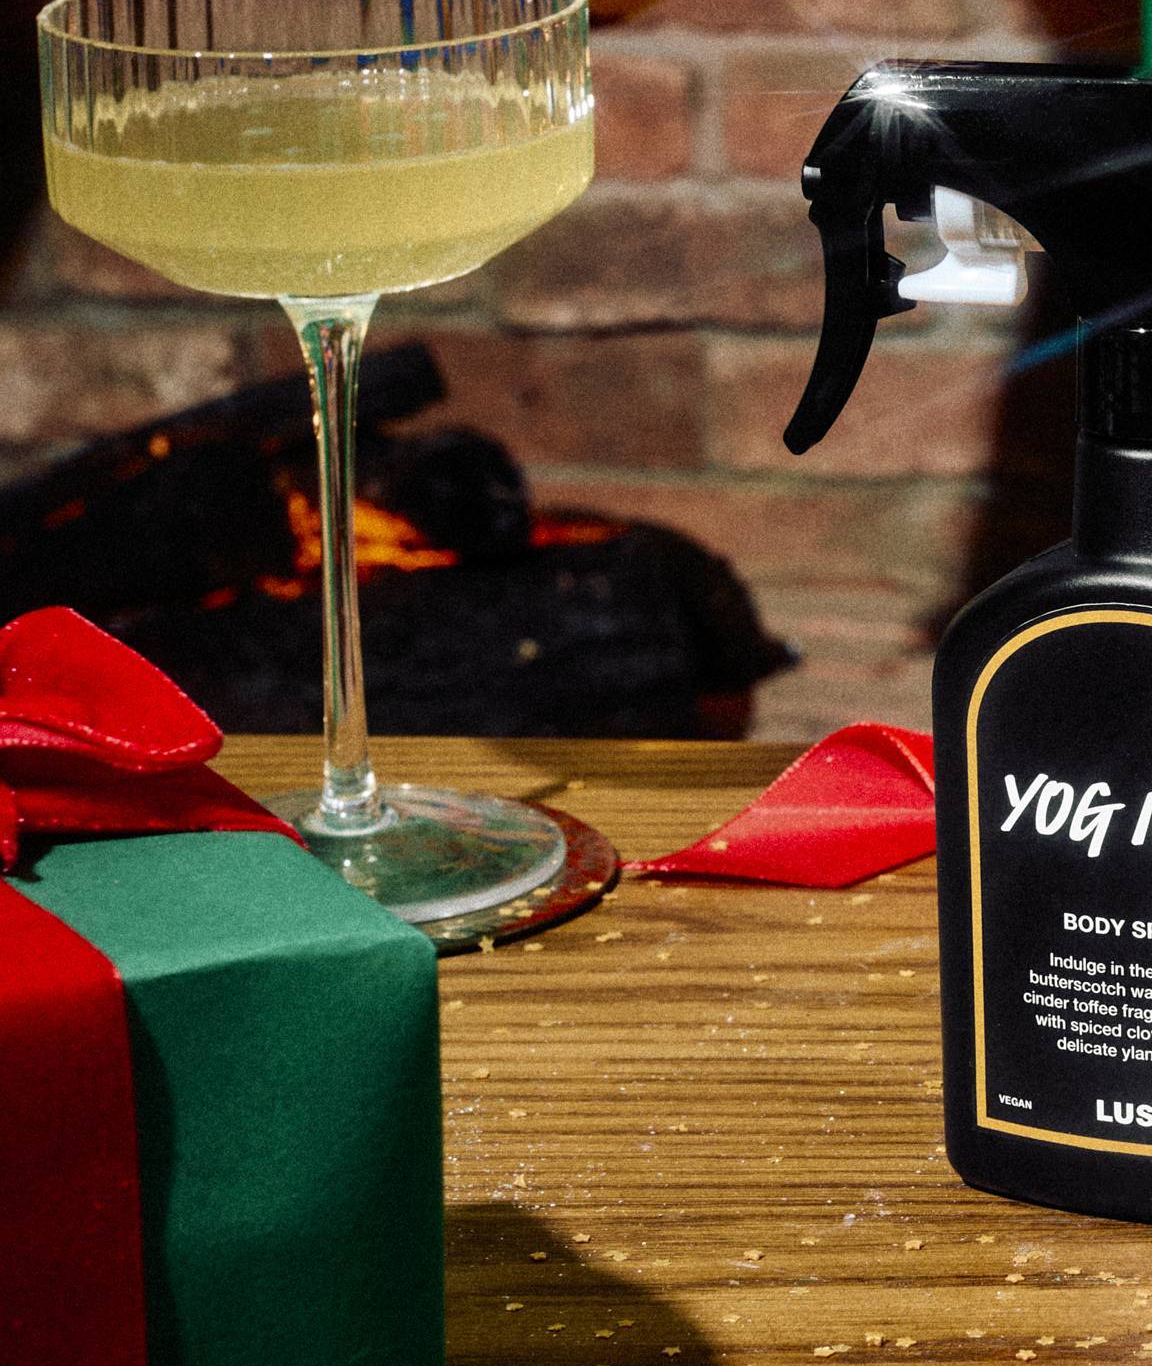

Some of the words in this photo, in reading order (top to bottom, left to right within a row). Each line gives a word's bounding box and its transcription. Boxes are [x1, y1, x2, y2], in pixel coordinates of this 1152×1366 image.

[1000, 772, 1127, 859] YOG
[1063, 912, 1126, 937] BODY
[1049, 952, 1107, 977] Indulge
[1110, 960, 1125, 977] in
[1029, 968, 1127, 997] butterscotch
[1022, 989, 1070, 1010] cinder
[1072, 997, 1119, 1017] toffee
[1034, 1013, 1067, 1031] with
[1070, 1019, 1123, 1038] spiced
[1056, 1036, 1118, 1058] delicate
[998, 1093, 1033, 1110] VEGAN
